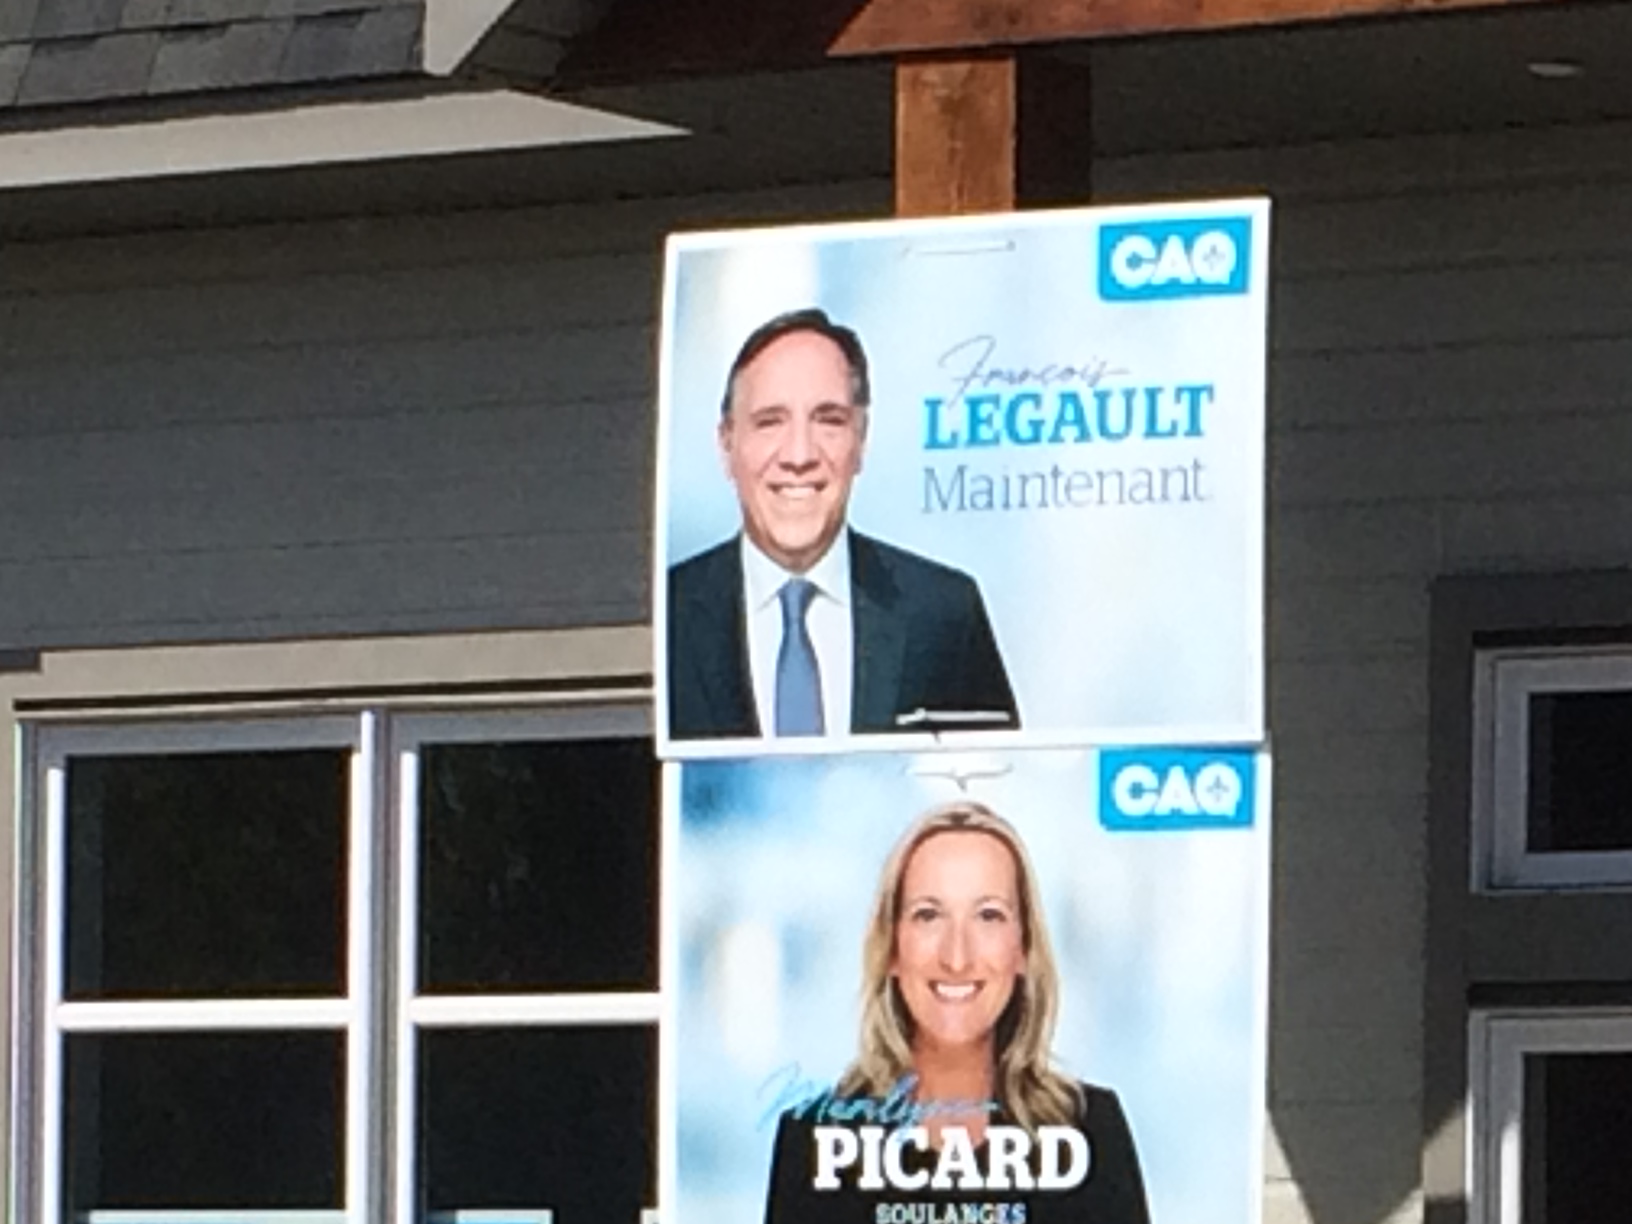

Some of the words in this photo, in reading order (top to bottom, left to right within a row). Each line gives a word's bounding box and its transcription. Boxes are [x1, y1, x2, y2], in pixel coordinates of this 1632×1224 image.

[1110, 231, 1238, 287] CAQ
[923, 384, 1215, 450] LEGAULT
[1112, 764, 1244, 817] CAQ
[813, 1126, 1091, 1192] PICARD
